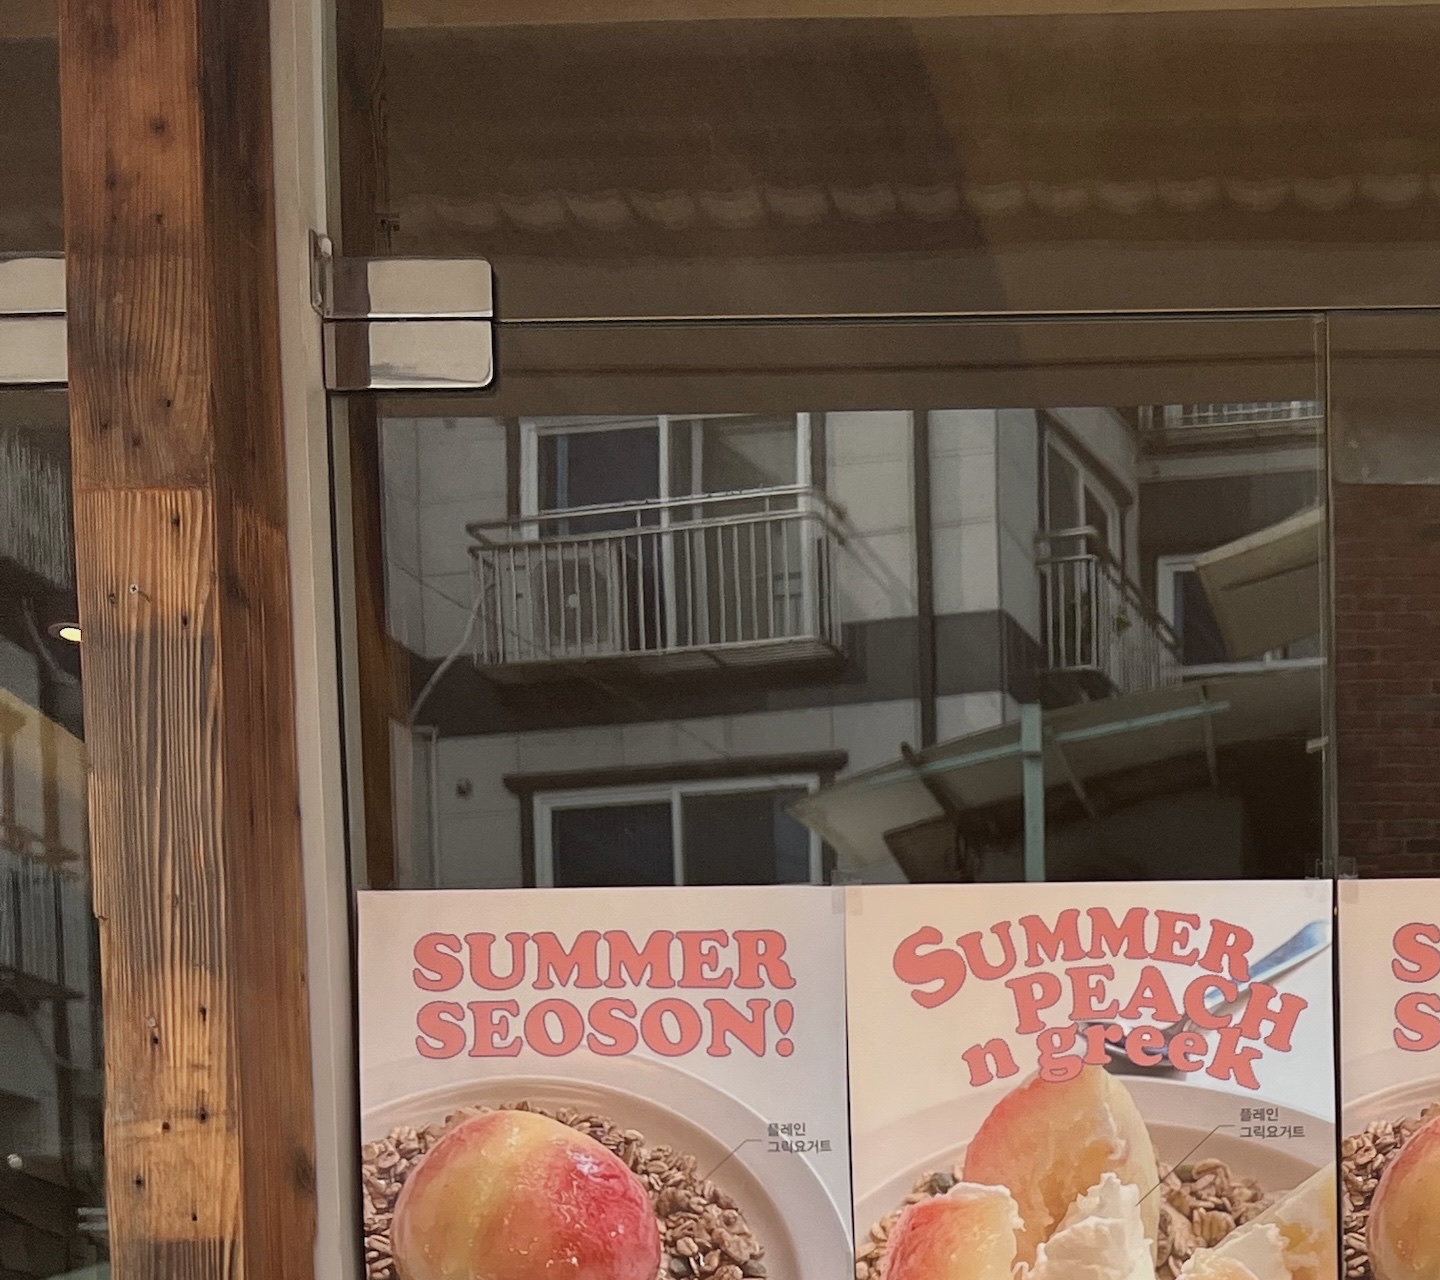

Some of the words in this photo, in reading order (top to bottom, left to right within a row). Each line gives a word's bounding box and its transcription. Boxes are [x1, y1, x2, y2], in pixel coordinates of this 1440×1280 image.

[412, 929, 797, 992] SUMMER
[892, 907, 1258, 1009] SUMMER
[415, 998, 796, 1060] SEOSON!
[1005, 964, 1308, 1053] PEACH
[961, 1036, 1020, 1087] n
[1037, 1021, 1264, 1090] greek
[767, 1122, 806, 1137] 플레인
[1239, 1125, 1305, 1139] 그릭요거트
[1240, 1107, 1279, 1122] 플레인
[767, 1139, 833, 1154] 그릭요거트
